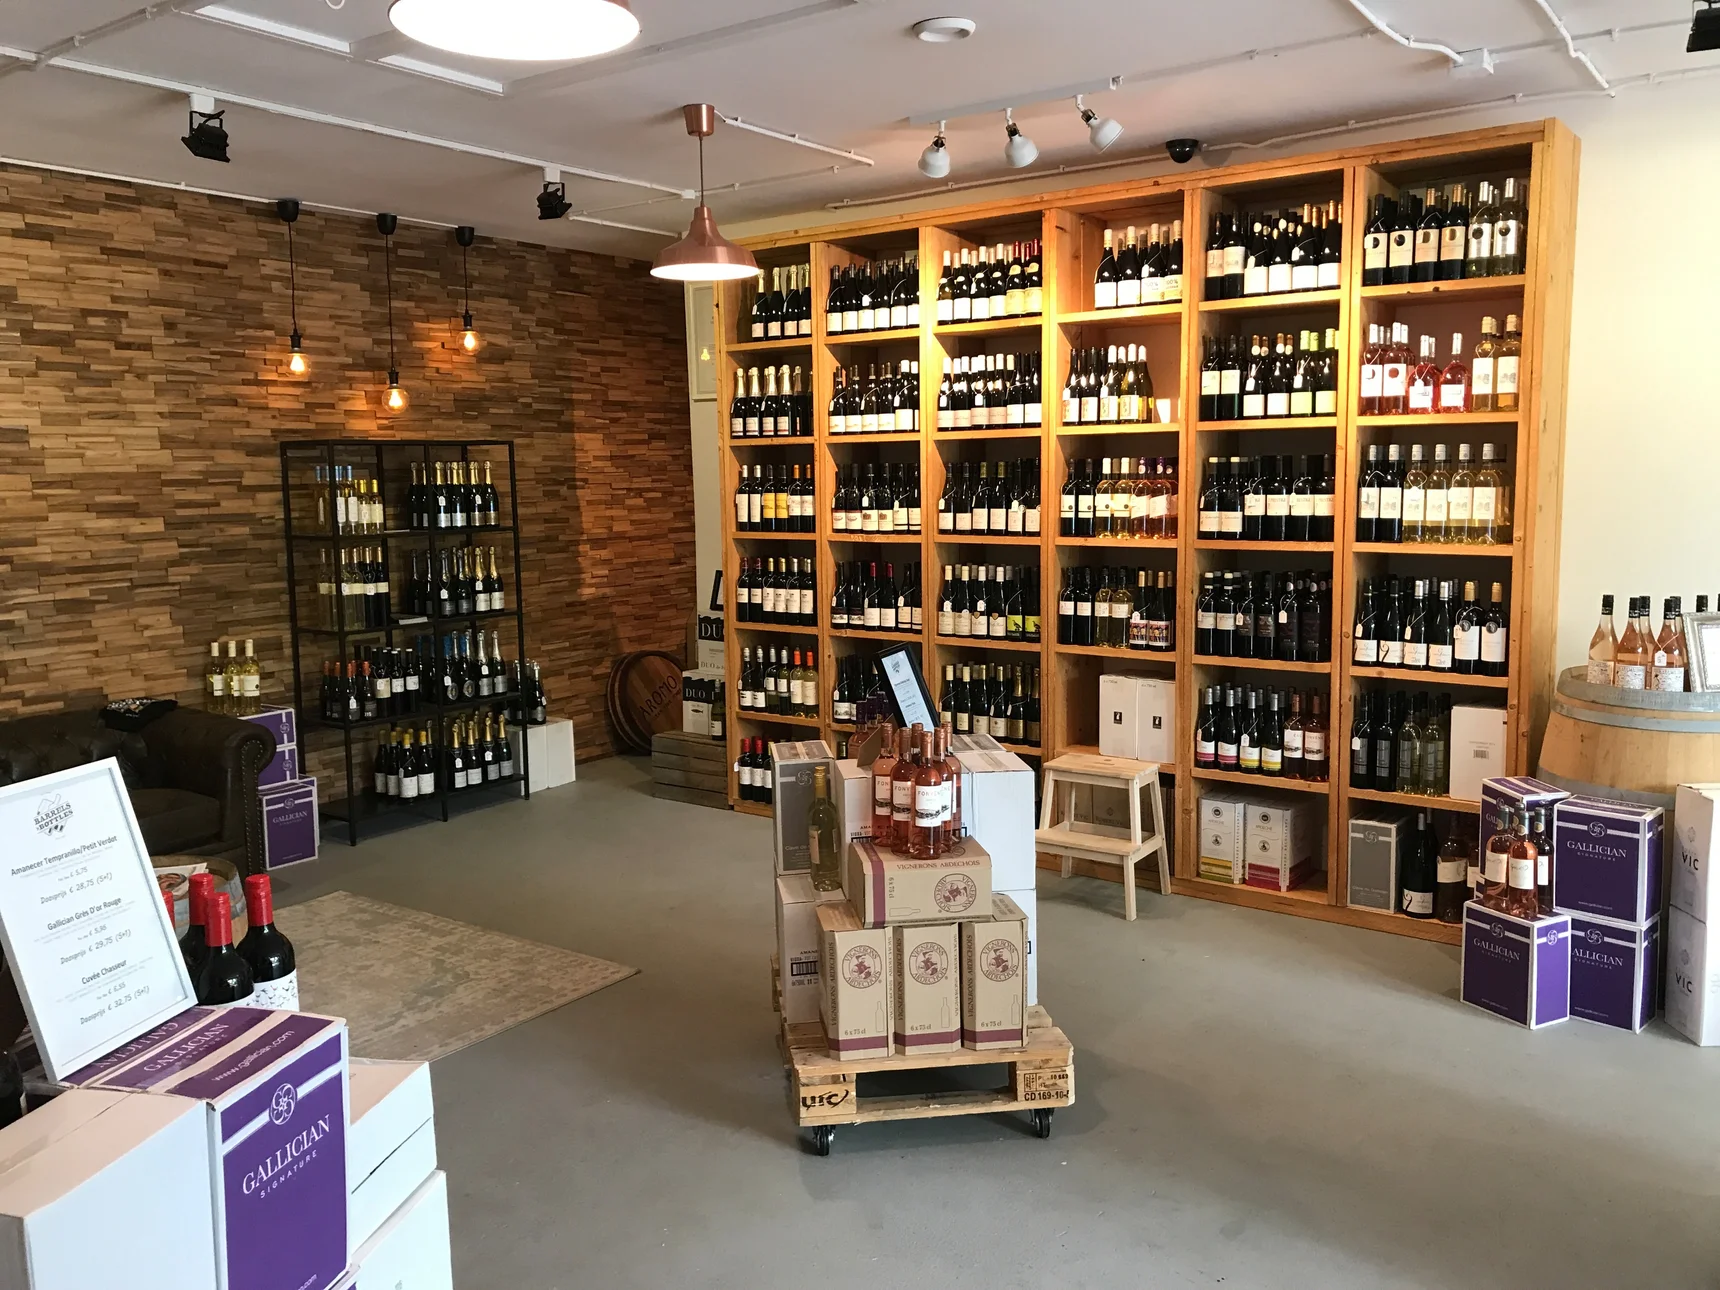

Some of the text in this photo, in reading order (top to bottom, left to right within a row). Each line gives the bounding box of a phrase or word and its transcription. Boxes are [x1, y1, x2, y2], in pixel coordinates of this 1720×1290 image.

[701, 623, 725, 638] DU
[639, 675, 678, 721] AROMO
[685, 688, 706, 699] DUO
[34, 802, 72, 826] BARRELS
[38, 809, 74, 831] BOTTLES
[272, 809, 308, 824] GALLICIAN
[11, 860, 44, 876] Amanecer
[97, 836, 118, 847] Verdot
[1566, 840, 1628, 858] GALLICIAN
[896, 860, 980, 870] VIGNERONS ARDECHOIS
[1682, 852, 1700, 871] VIC
[76, 878, 94, 892] 28,75
[96, 872, 113, 885] (5+1)
[47, 916, 74, 930] Gallician
[103, 898, 122, 909] Rouge
[95, 936, 114, 950] 29,75
[115, 928, 132, 942] (5+1)
[982, 940, 1015, 956] VIGNERONS
[844, 946, 878, 962] VIGNERONS
[911, 942, 944, 958] VIGNERONS
[1474, 937, 1521, 961] GALLICIAN
[1572, 948, 1624, 967] ALLICIAN
[82, 959, 128, 985] Cuvée Chasseur
[846, 970, 881, 988] ARDECHOIS
[912, 967, 947, 984] ARDECHOIS
[984, 964, 1018, 982] ARDECHOIS
[1675, 972, 1693, 994] VIC
[134, 986, 150, 1000] (5+1)
[142, 1022, 230, 1072] GALLICIAN
[1024, 1092, 1036, 1102] CD
[242, 1114, 331, 1196] GALLICIAN
[260, 1150, 318, 1199] SIGNATURE
